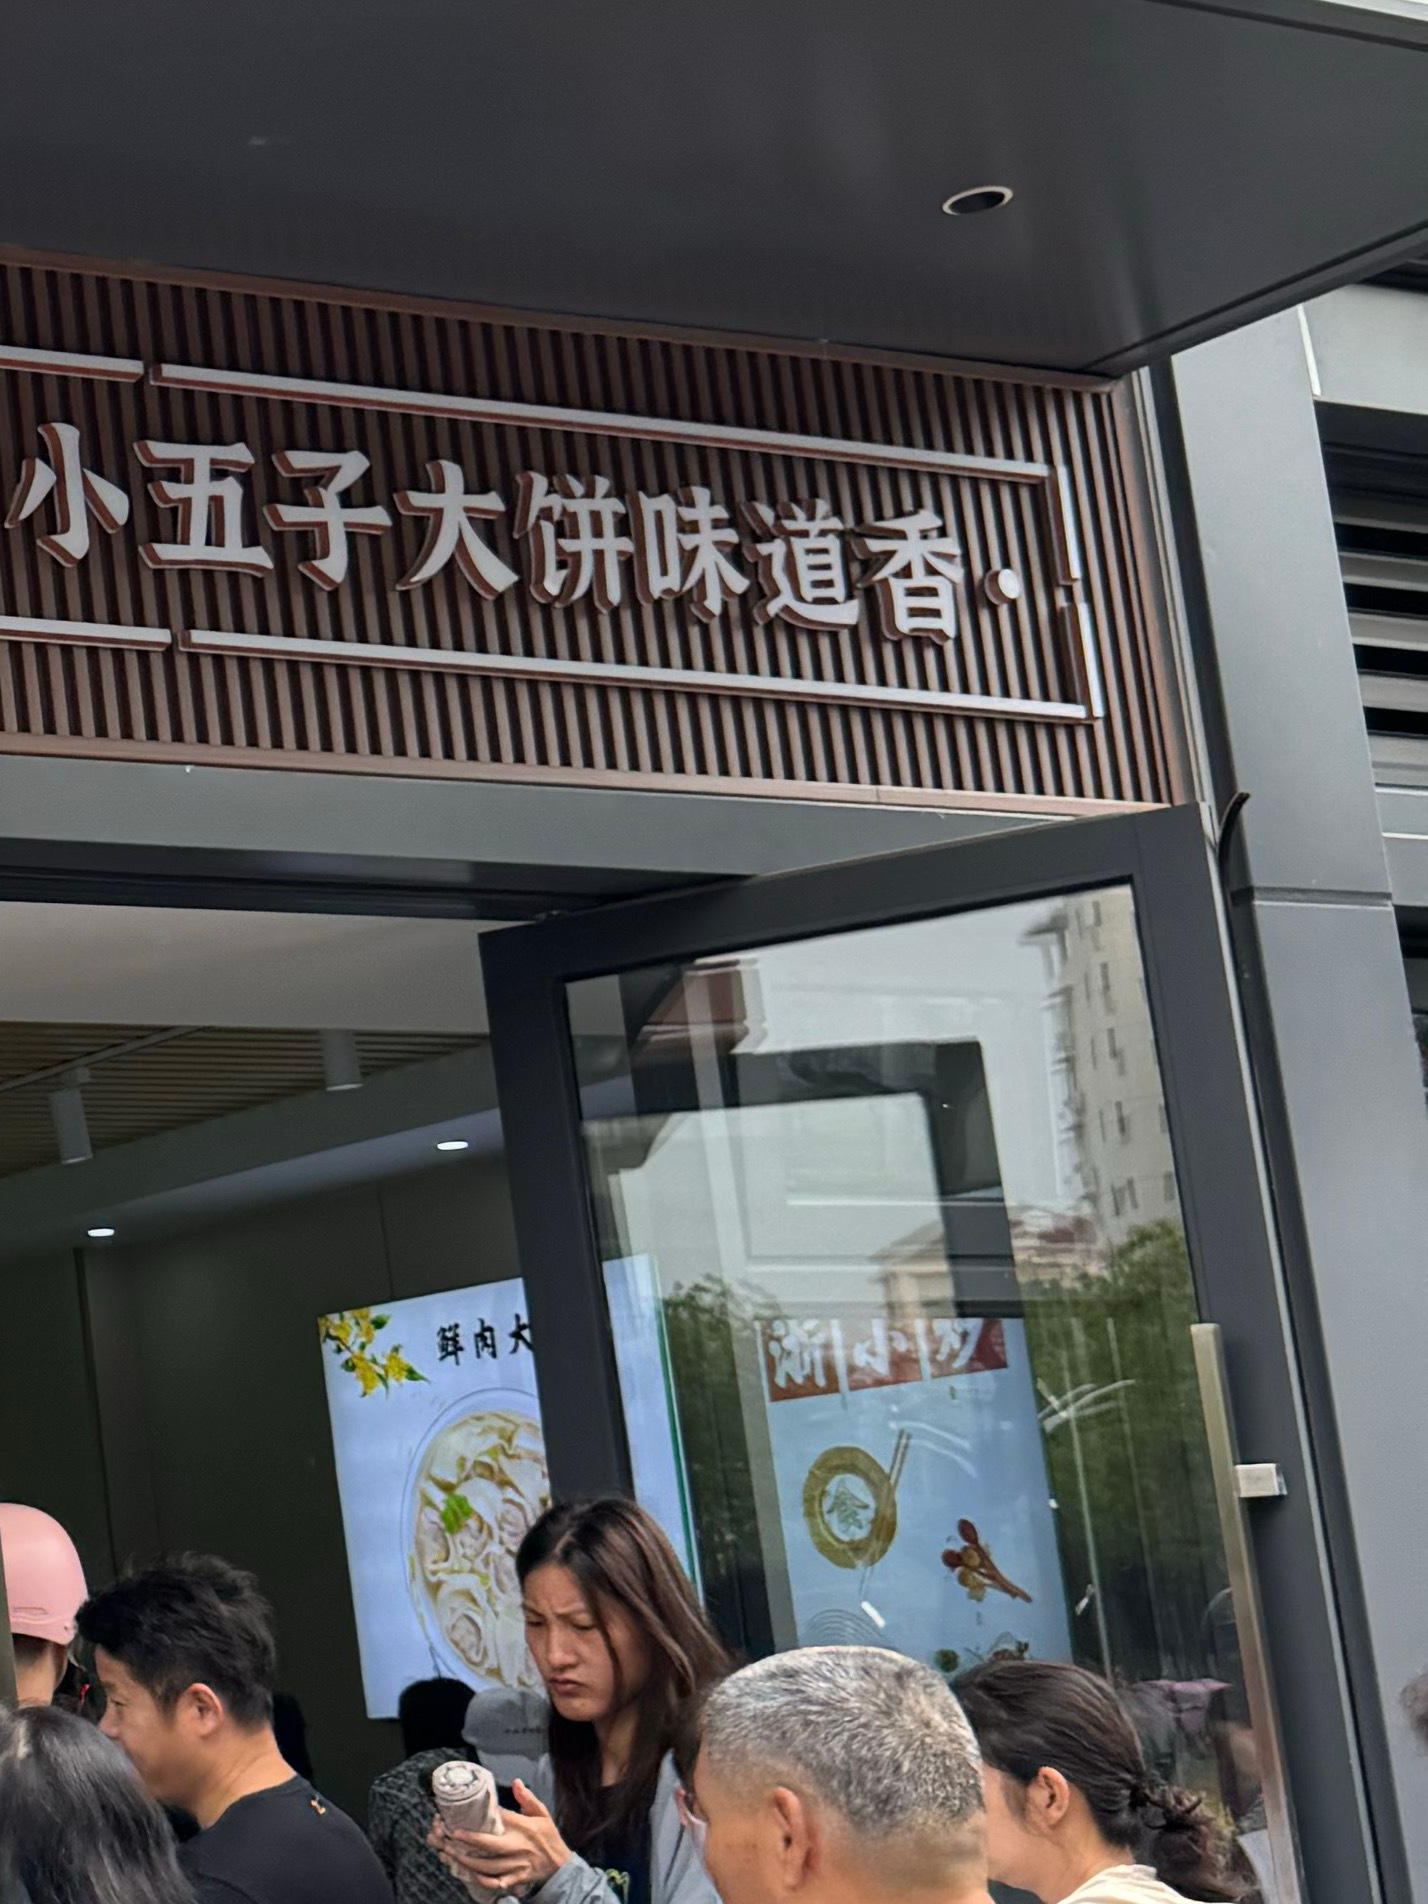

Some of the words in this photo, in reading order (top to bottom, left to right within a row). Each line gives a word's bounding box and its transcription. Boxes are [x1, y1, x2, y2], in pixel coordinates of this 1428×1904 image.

[4, 421, 965, 647] 小五子大饼味道香
